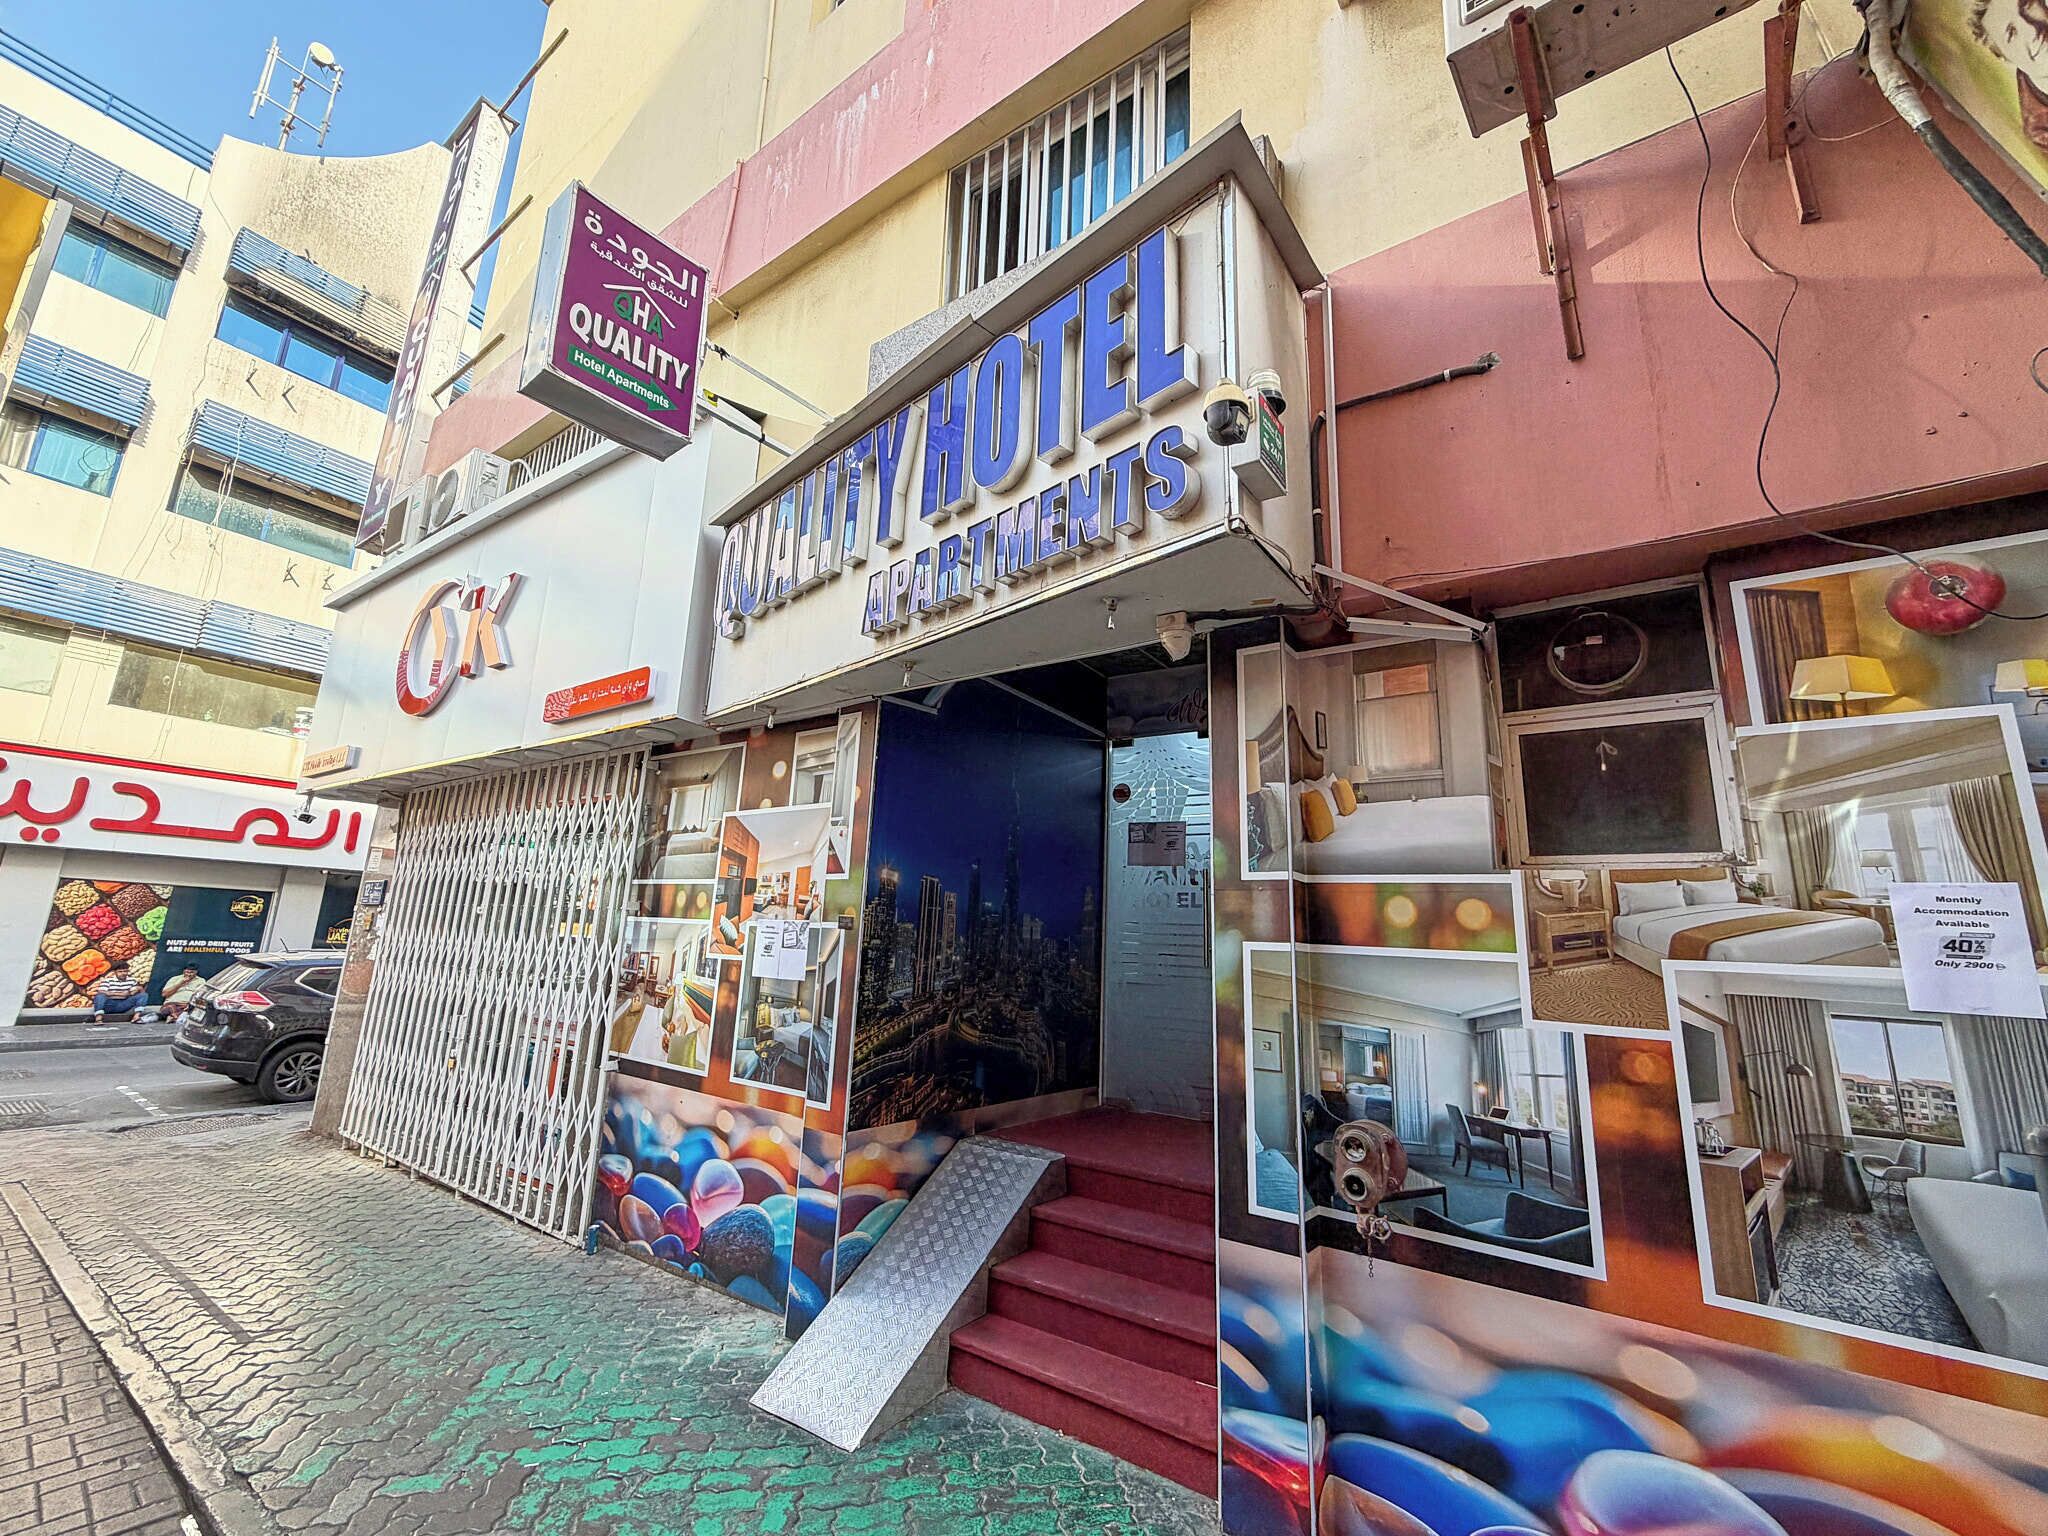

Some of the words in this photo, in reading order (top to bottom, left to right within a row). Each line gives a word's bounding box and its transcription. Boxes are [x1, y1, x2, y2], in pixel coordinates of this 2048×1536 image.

[584, 209, 699, 298] الجودة
[613, 291, 664, 341] QHA
[569, 302, 691, 390] QUALITY
[574, 351, 606, 375] Hotel
[606, 367, 670, 409] Apartments
[716, 404, 921, 640] QUALITY
[920, 227, 1200, 526] HOTEL
[860, 425, 1201, 639] APARTMENTS
[1935, 895, 1982, 905] Monthly
[1913, 907, 2010, 917] Accommodation
[1935, 920, 1990, 929] Available
[327, 932, 347, 941] UAE
[166, 939, 189, 947] NUTS
[207, 940, 230, 948] DRIED
[230, 941, 255, 949] FRUITS
[225, 947, 251, 955] FOODS
[1934, 959, 1962, 969] Only
[1964, 961, 1994, 970] 2900
